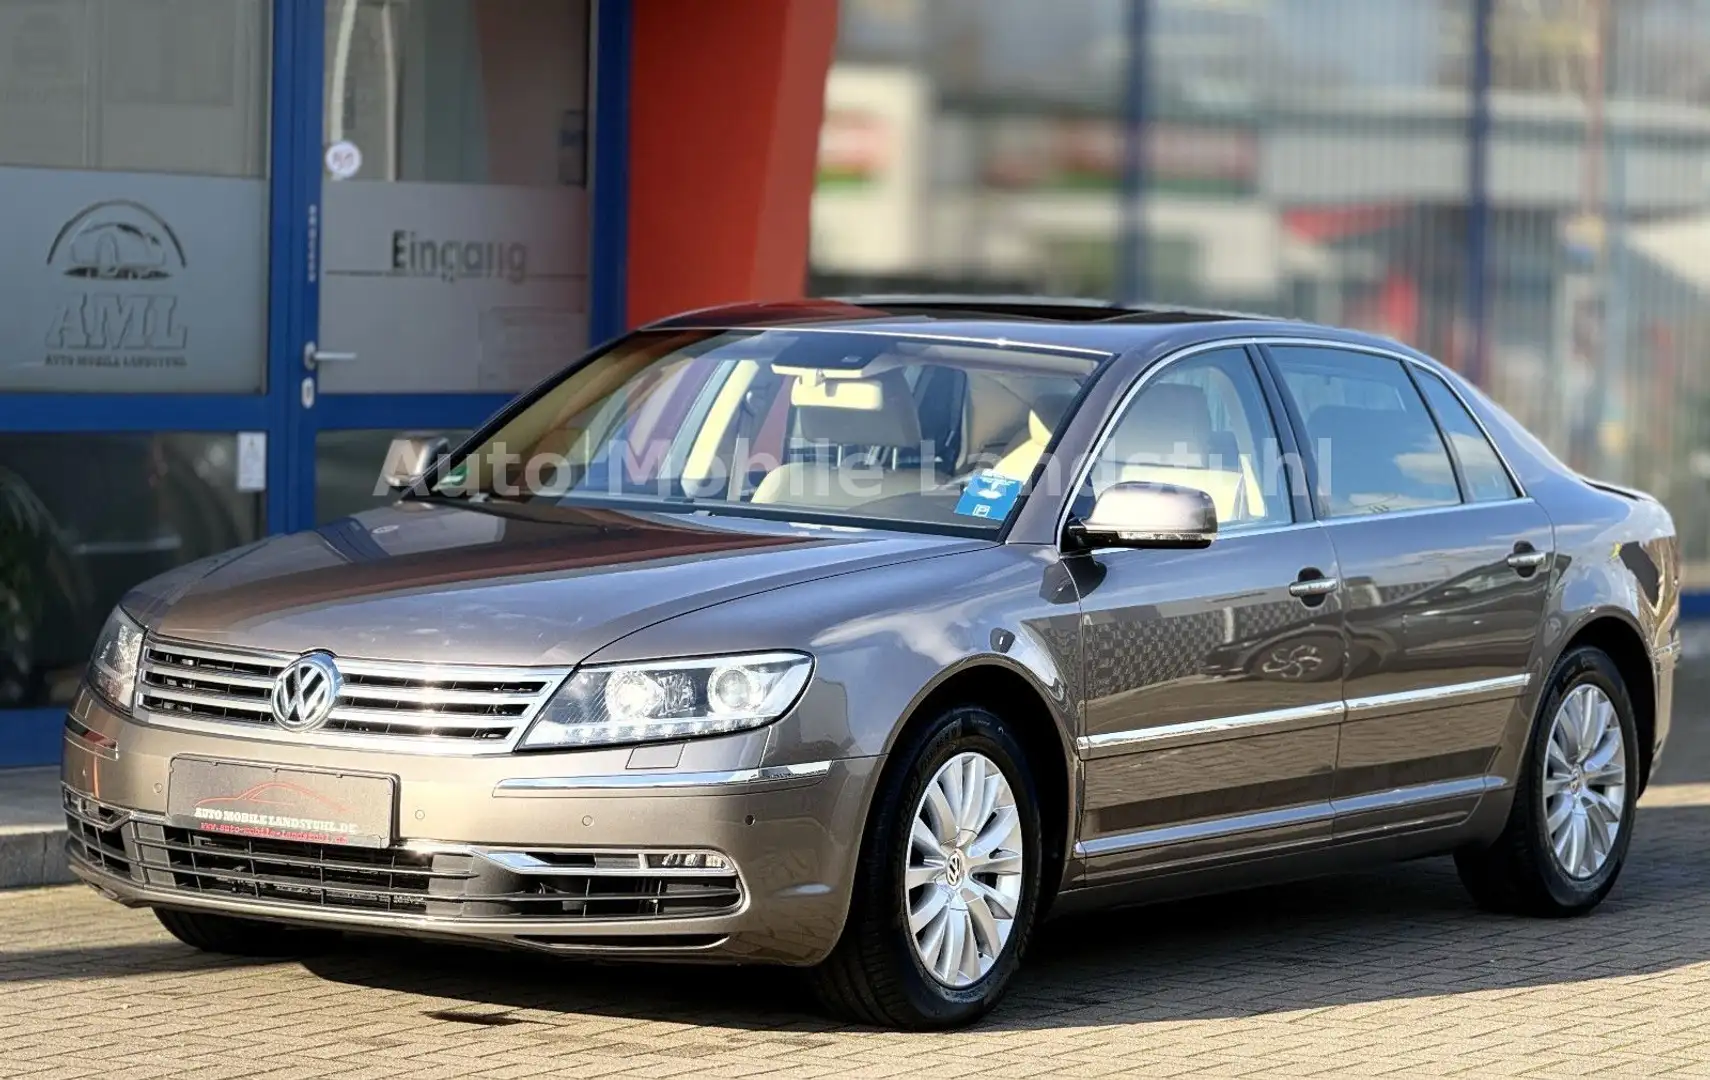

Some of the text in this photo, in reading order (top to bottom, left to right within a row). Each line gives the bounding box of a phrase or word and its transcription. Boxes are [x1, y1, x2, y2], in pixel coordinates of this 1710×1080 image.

[391, 229, 528, 285] Eingang
[45, 292, 188, 350] AML
[194, 807, 223, 821] AUTO
[223, 811, 268, 825] MOBILE
